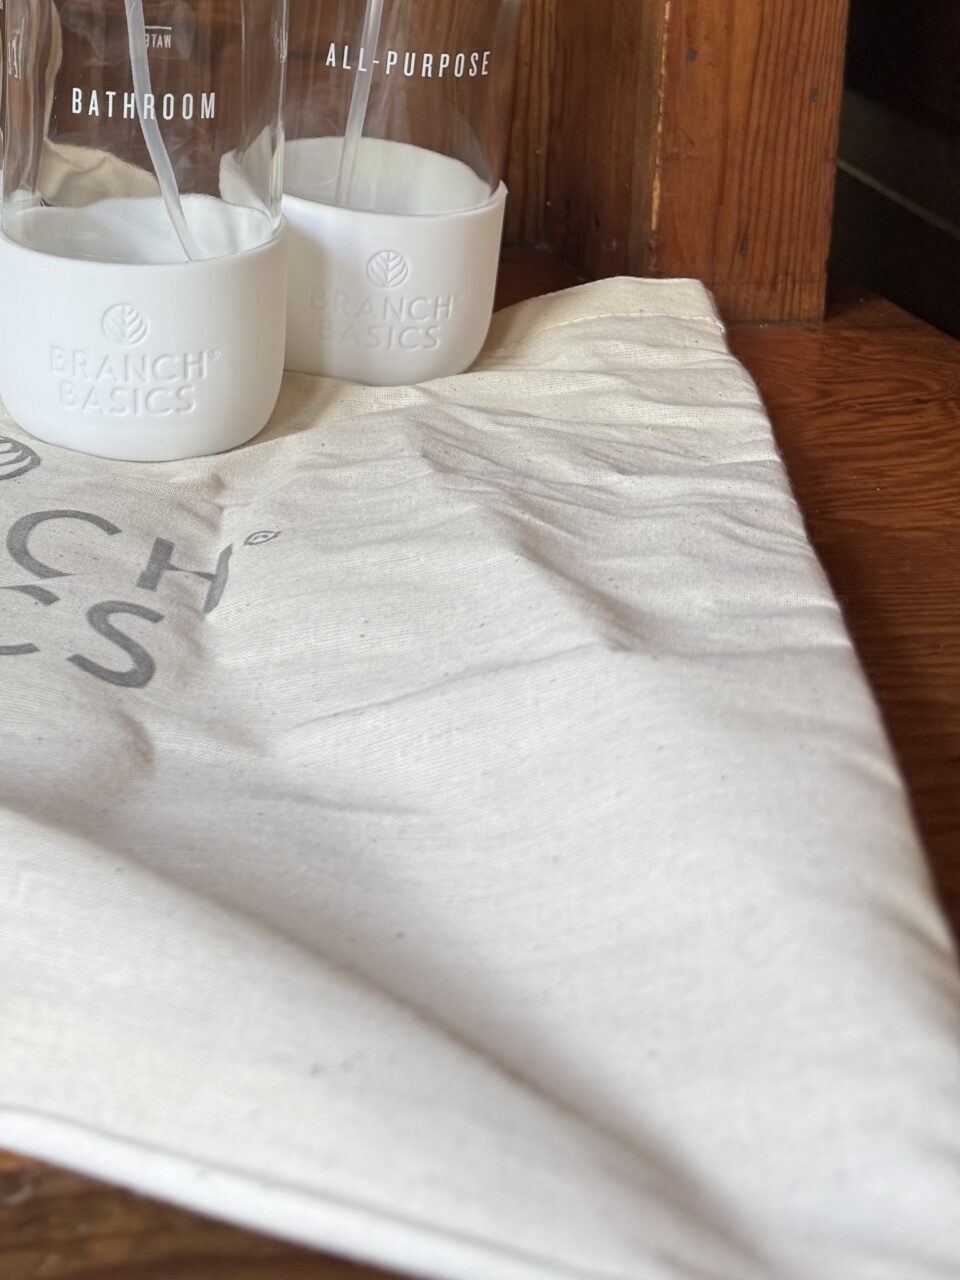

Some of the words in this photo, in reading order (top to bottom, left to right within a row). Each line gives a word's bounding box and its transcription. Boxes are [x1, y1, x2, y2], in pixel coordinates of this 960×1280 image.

[325, 42, 490, 78] ALL-PURPOSE
[71, 87, 216, 120] BATHROOM
[58, 379, 198, 417] BASICS
